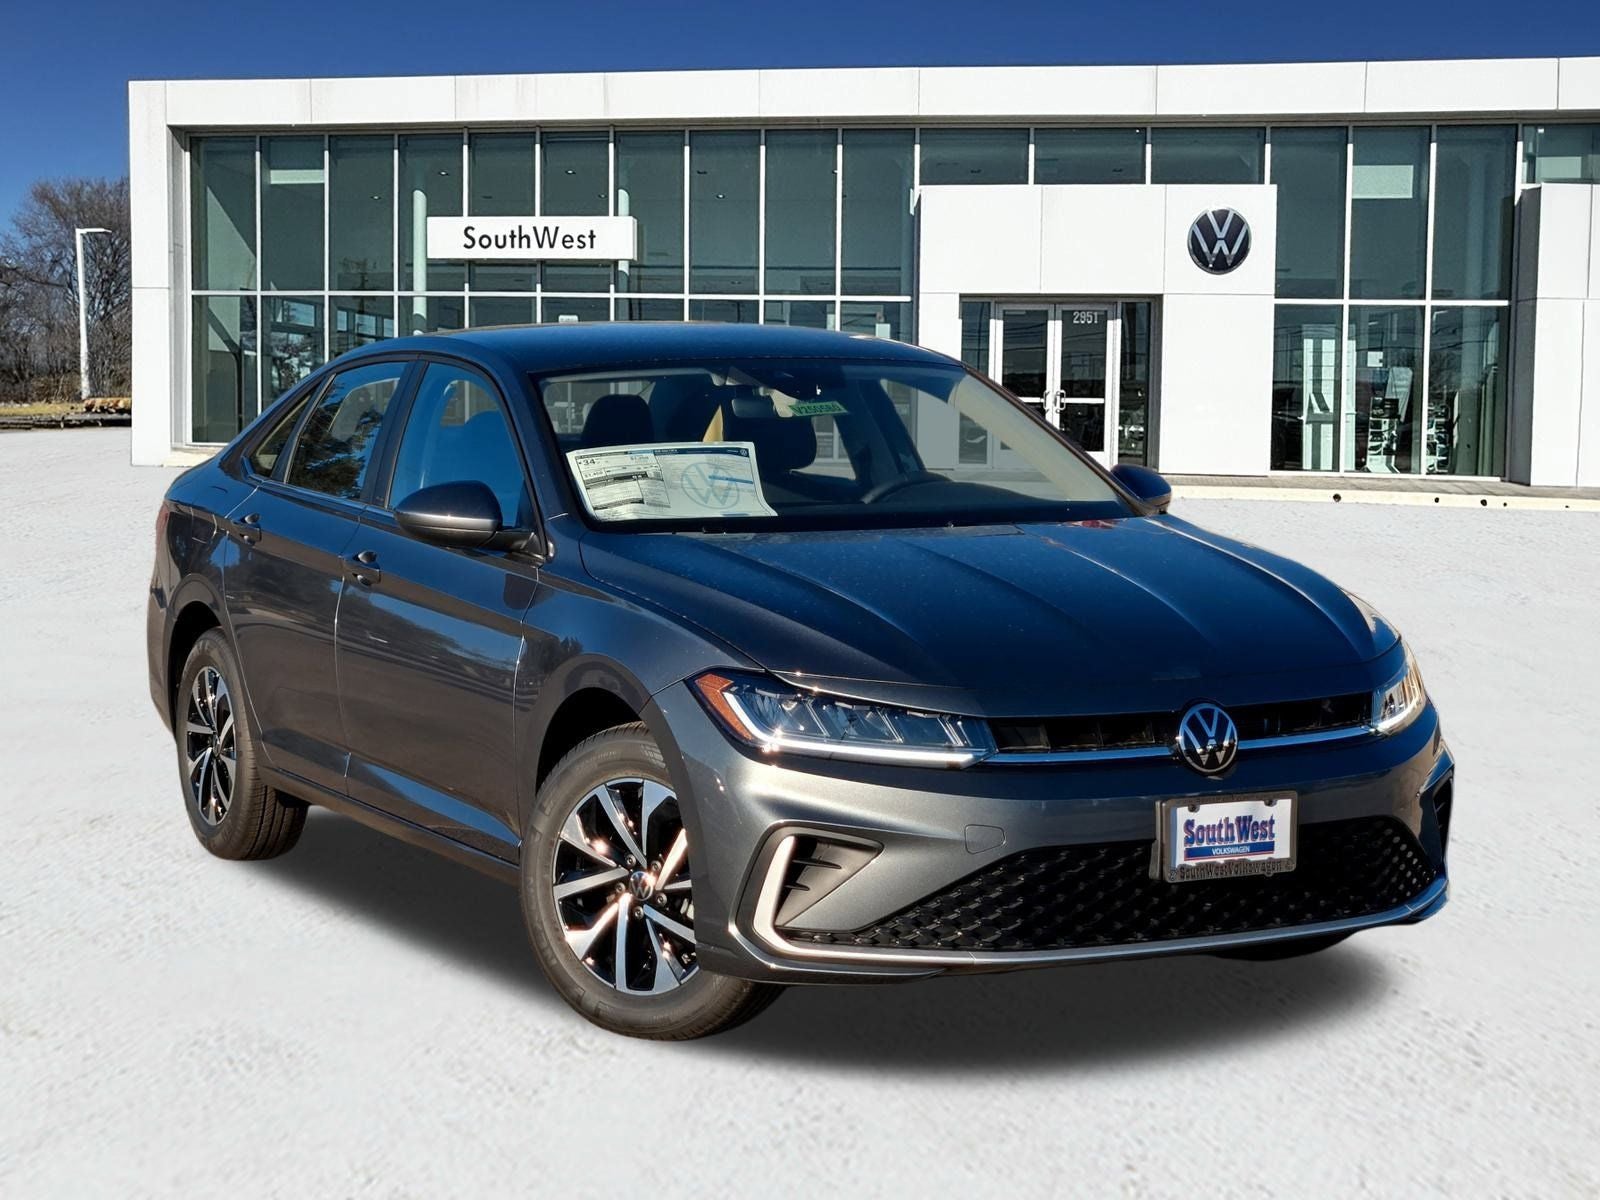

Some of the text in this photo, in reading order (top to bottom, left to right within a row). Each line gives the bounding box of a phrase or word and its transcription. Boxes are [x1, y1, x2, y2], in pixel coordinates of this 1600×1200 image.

[463, 224, 596, 249] SouthWest
[1188, 207, 1251, 272] VW
[1072, 311, 1098, 324] 2951
[1180, 704, 1236, 770] VW
[1183, 814, 1275, 847] SouthWest
[1211, 845, 1250, 856] VOLKSWAGEN
